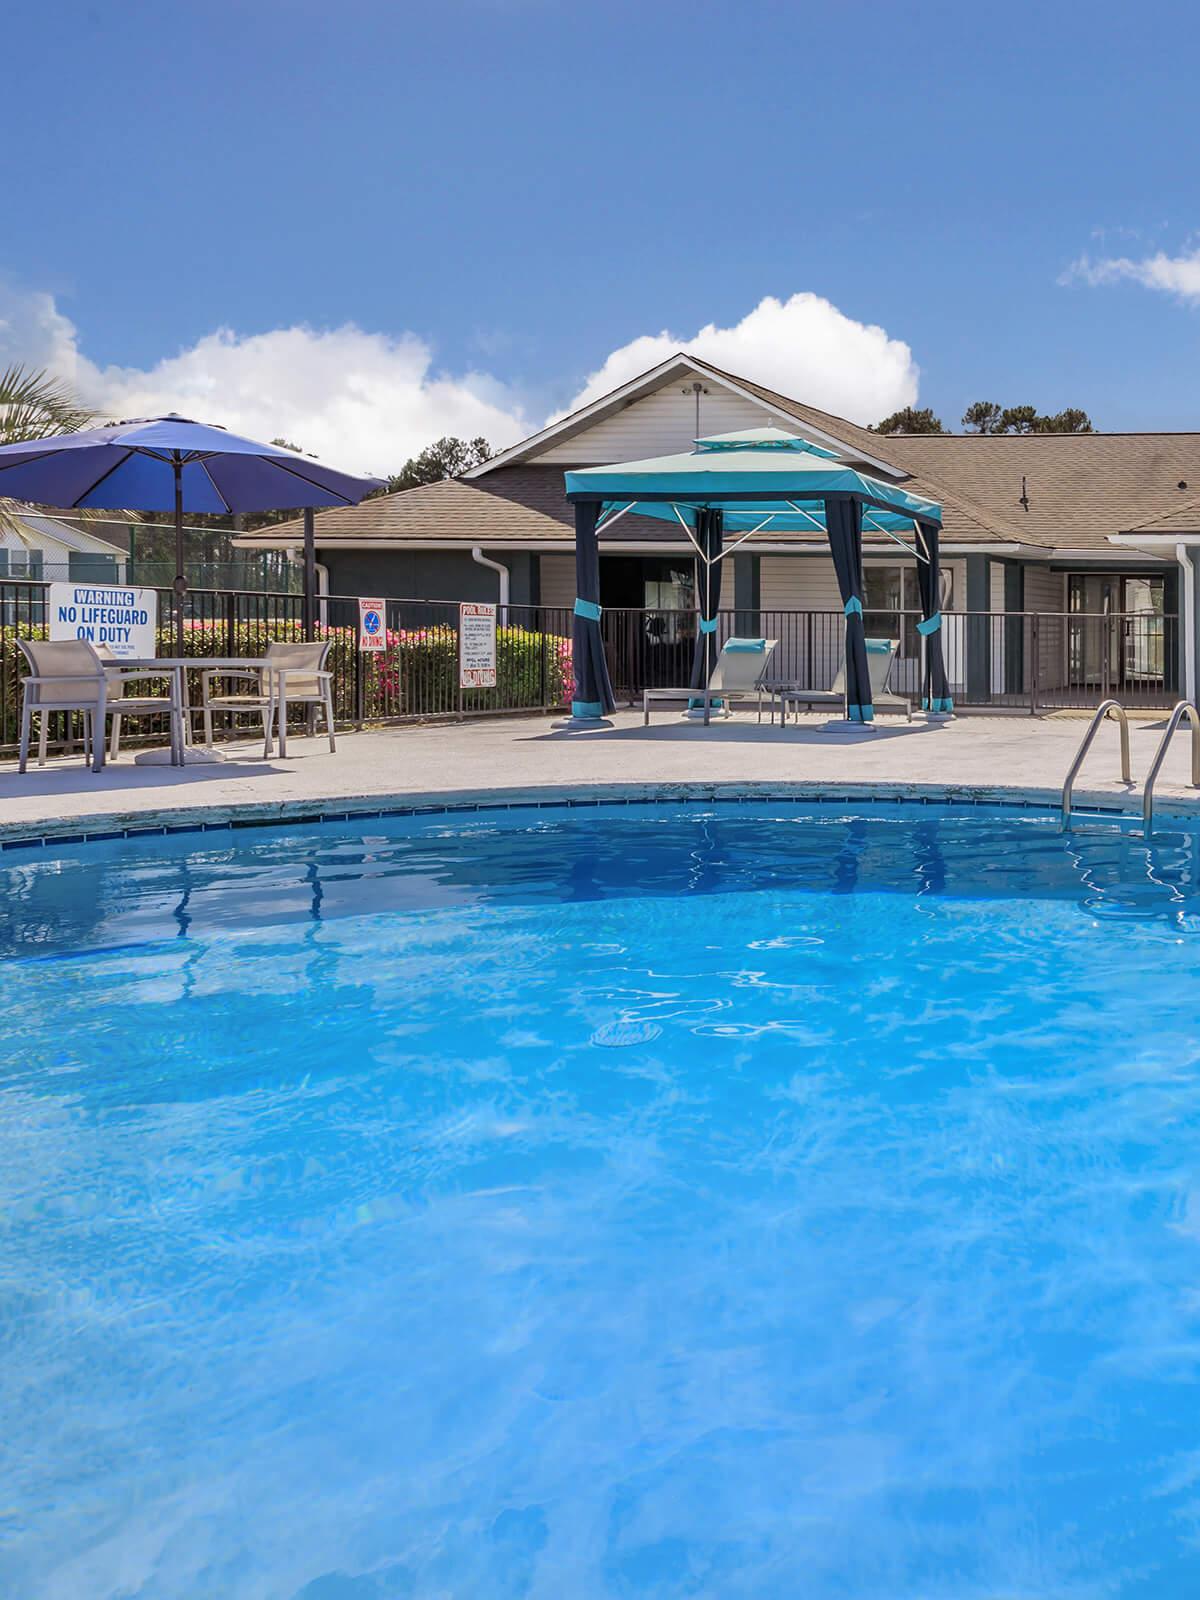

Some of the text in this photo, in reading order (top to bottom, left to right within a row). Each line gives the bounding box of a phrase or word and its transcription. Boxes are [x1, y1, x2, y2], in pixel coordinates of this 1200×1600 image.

[76, 590, 133, 606] WARNING
[59, 607, 148, 625] NO LIFEGUARD
[464, 605, 478, 615] POOL
[77, 626, 131, 643] ON DUTY
[362, 636, 368, 647] NO
[464, 669, 473, 685] NO
